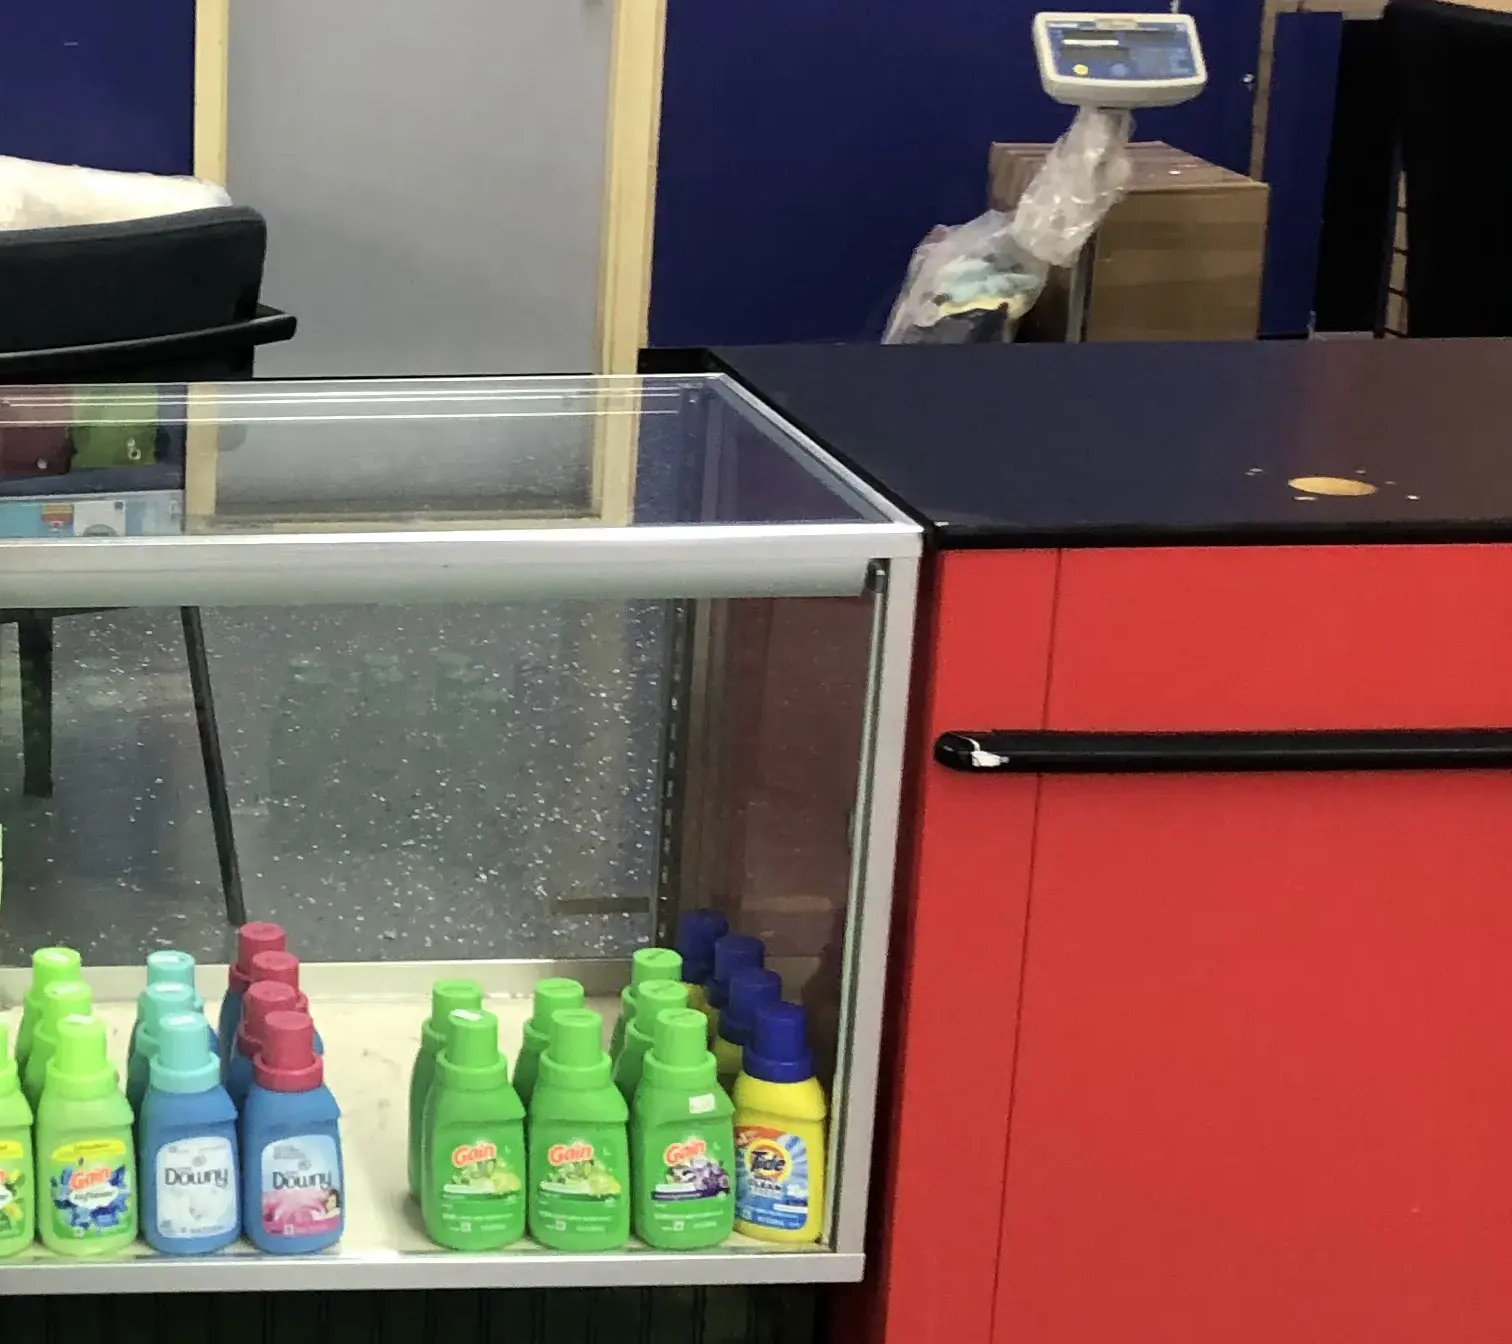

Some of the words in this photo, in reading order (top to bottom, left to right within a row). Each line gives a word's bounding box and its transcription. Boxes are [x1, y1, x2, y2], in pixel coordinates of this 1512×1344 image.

[452, 1142, 496, 1167] Gain
[548, 1142, 594, 1167] Gain
[750, 1150, 786, 1172] Tide
[164, 1167, 229, 1188] Downy
[272, 1170, 333, 1191] Downy
